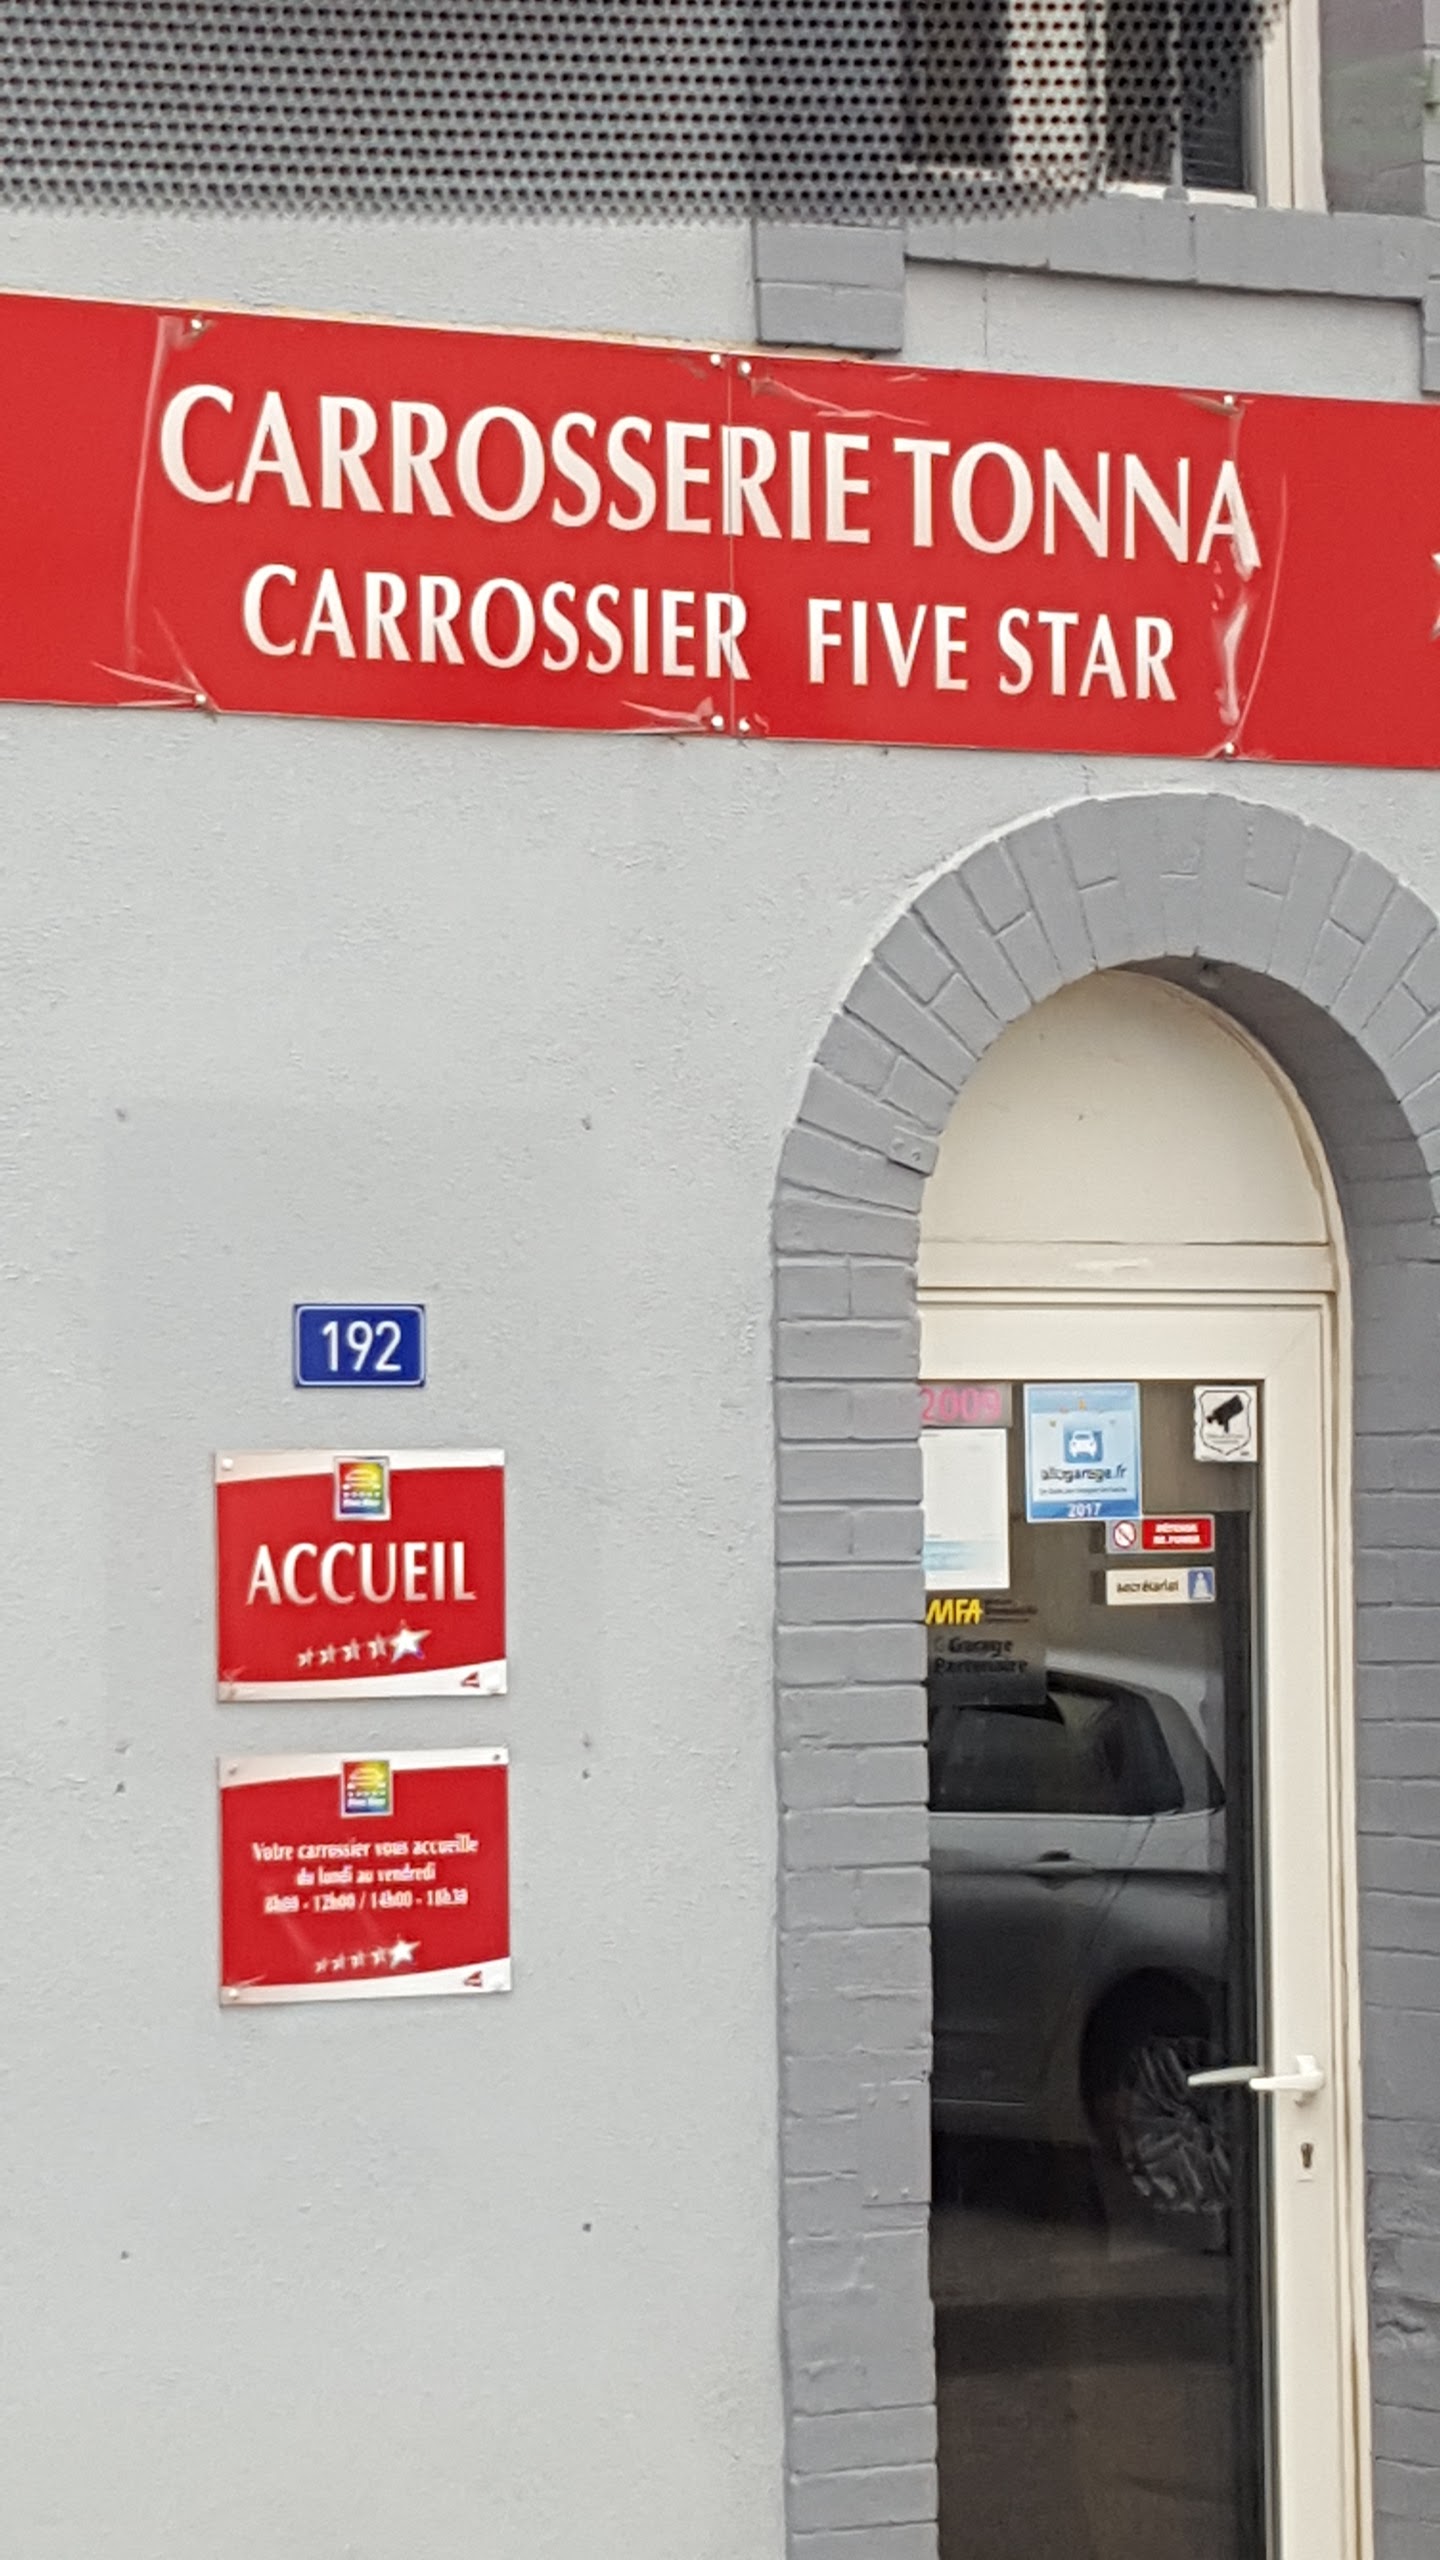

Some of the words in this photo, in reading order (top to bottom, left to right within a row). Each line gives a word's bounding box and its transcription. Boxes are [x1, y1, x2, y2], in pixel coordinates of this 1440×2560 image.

[159, 383, 871, 545] CARROSSERIE
[894, 437, 1261, 580] TONNA
[242, 563, 751, 682] CARROSSIER
[807, 598, 968, 692] FIVE
[998, 608, 1176, 702] STAR
[321, 1320, 402, 1373] 192
[920, 1386, 1001, 1422] 2009
[1067, 1502, 1102, 1518] 2017
[245, 1541, 477, 1606] ACCUEIL
[925, 1598, 981, 1624] MFA
[252, 1842, 294, 1861] Votre
[297, 1842, 371, 1860] carrossier
[375, 1841, 408, 1857] vous
[412, 1832, 479, 1856] accueille
[296, 1867, 315, 1886] du
[318, 1865, 353, 1885] lundi
[356, 1869, 374, 1884] au
[377, 1862, 436, 1882] vendredi
